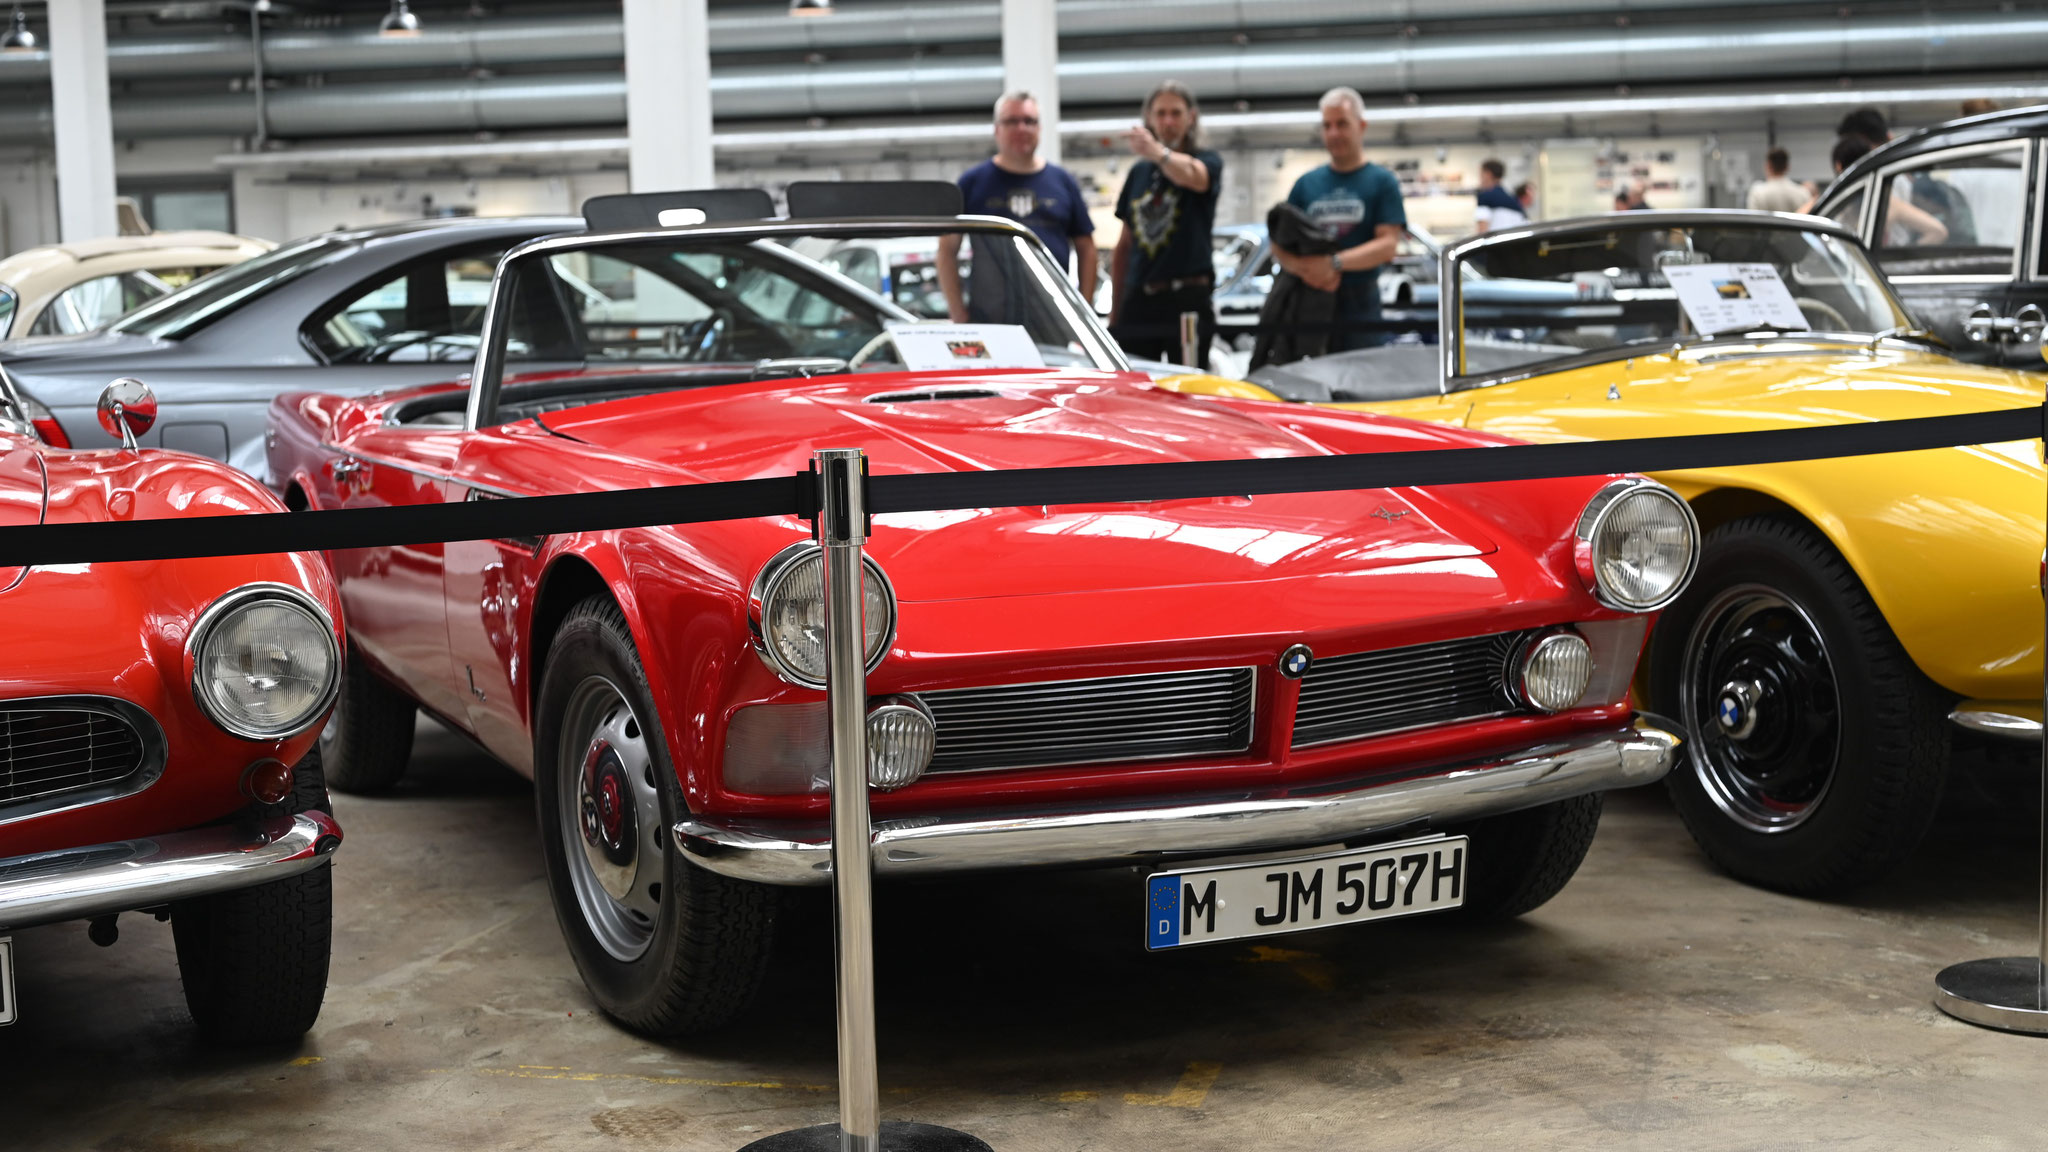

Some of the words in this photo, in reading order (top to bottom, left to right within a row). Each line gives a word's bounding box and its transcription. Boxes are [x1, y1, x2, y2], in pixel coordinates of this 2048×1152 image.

[1183, 879, 1217, 936] M
[1255, 867, 1324, 926] JM
[1336, 847, 1463, 915] 507H
[1159, 919, 1170, 934] D
